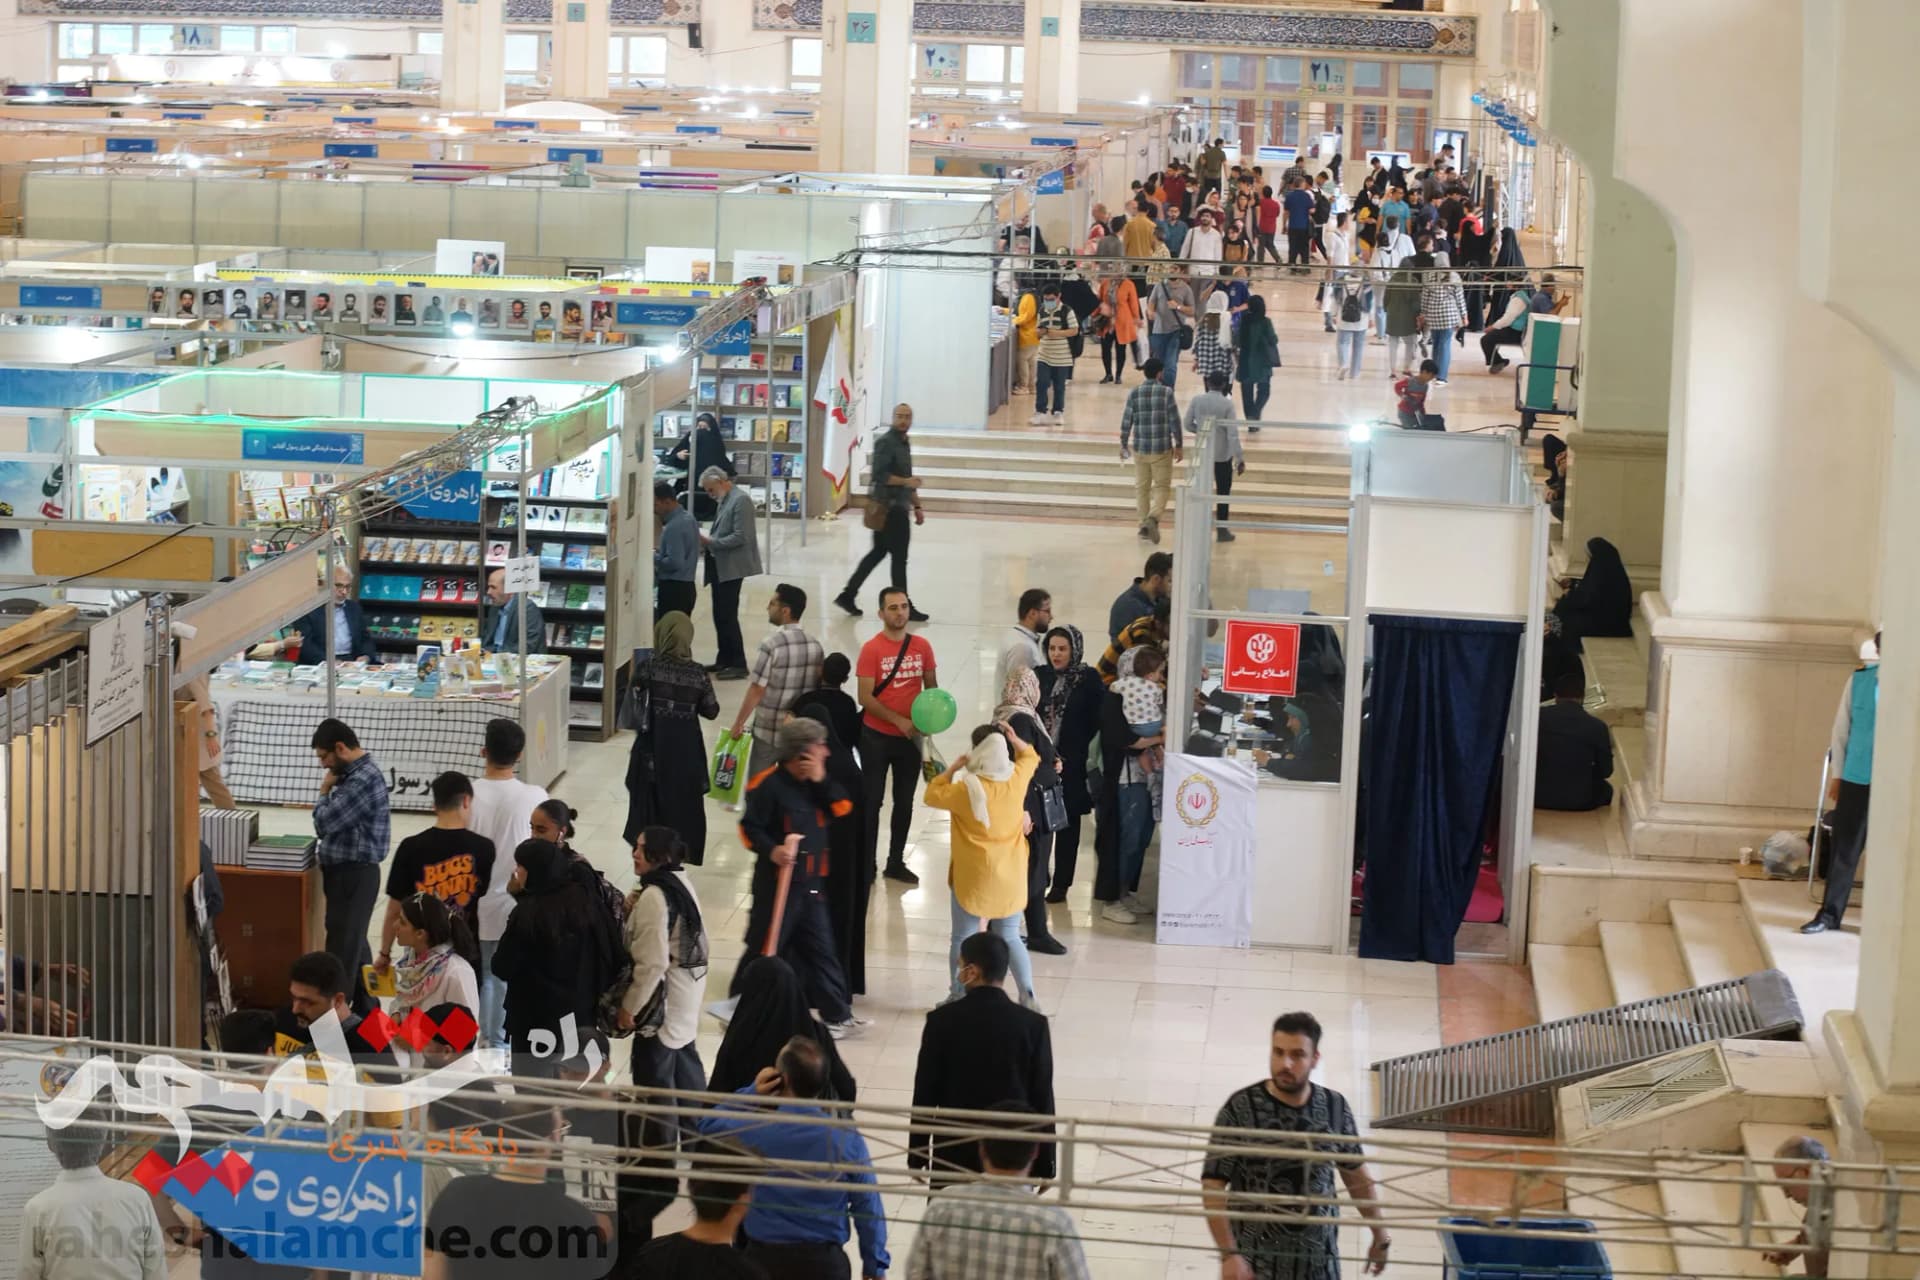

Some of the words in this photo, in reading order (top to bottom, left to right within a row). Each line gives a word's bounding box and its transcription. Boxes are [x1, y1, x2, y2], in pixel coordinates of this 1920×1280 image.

[1311, 62, 1330, 82] ۲۱
[429, 483, 480, 505] راهروی
[287, 1170, 418, 1227] راهروی
